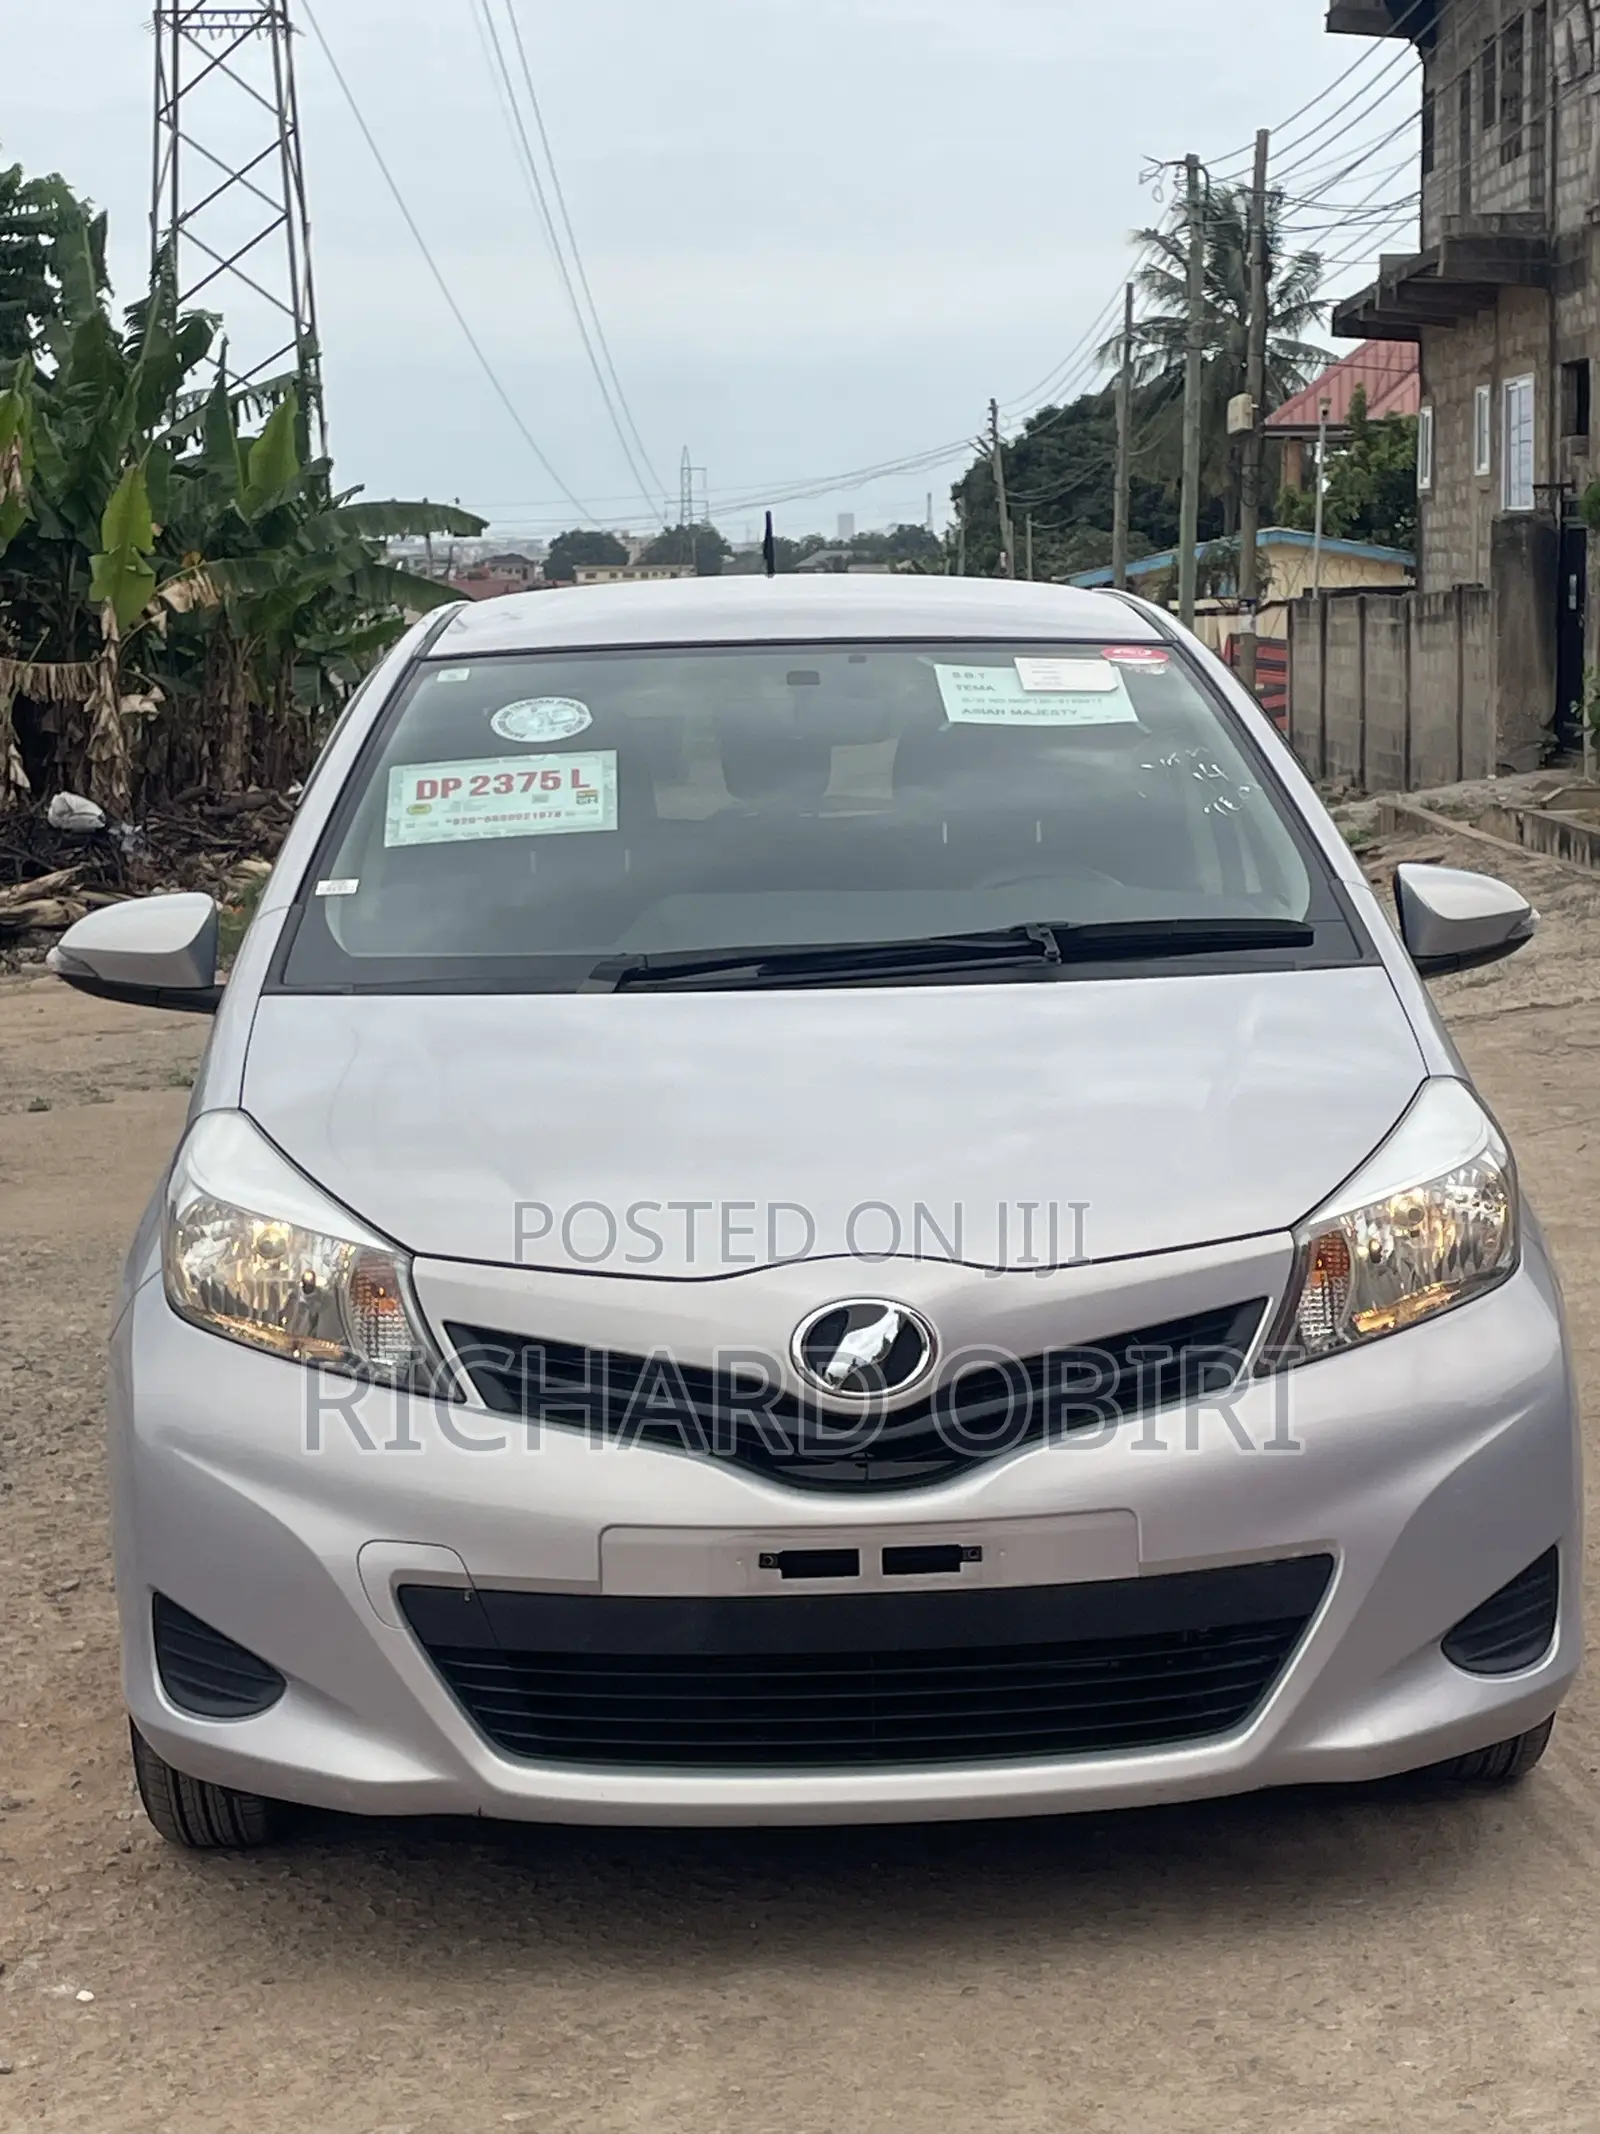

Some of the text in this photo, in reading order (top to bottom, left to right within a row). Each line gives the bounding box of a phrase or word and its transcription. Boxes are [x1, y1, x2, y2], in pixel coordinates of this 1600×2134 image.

[956, 683, 996, 692] TEMA
[962, 708, 1005, 717] ASIAN
[1010, 708, 1077, 717] MAJESTY
[416, 768, 591, 801] DP 2375 L
